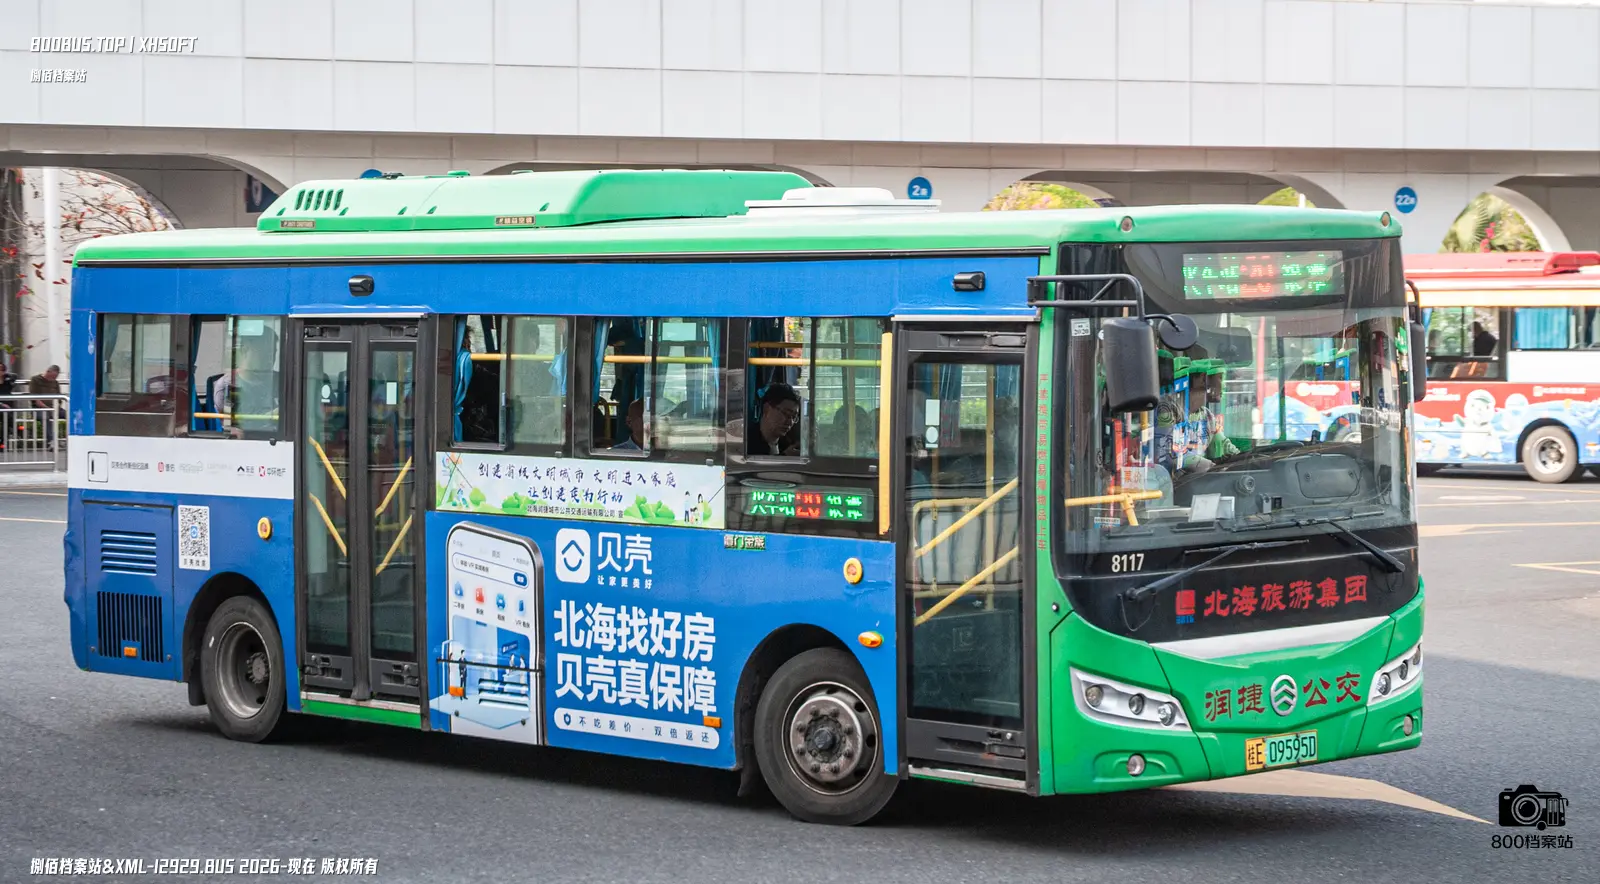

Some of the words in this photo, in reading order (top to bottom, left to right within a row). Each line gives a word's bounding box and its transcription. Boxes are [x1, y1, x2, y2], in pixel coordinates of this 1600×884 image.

[477, 462, 585, 484] 创建省级文明城市
[592, 468, 678, 489] 文明进入家庭
[597, 531, 653, 575] 贝壳
[1111, 553, 1145, 573] 8117
[597, 575, 653, 590] 让家更美好
[1203, 574, 1368, 617] 北海旅游集团
[553, 599, 717, 663] 北海找好房
[555, 652, 718, 717] 贝壳真保障
[1205, 683, 1266, 722] 润捷
[1302, 671, 1362, 708] 公交
[1269, 735, 1316, 763] 09595D
